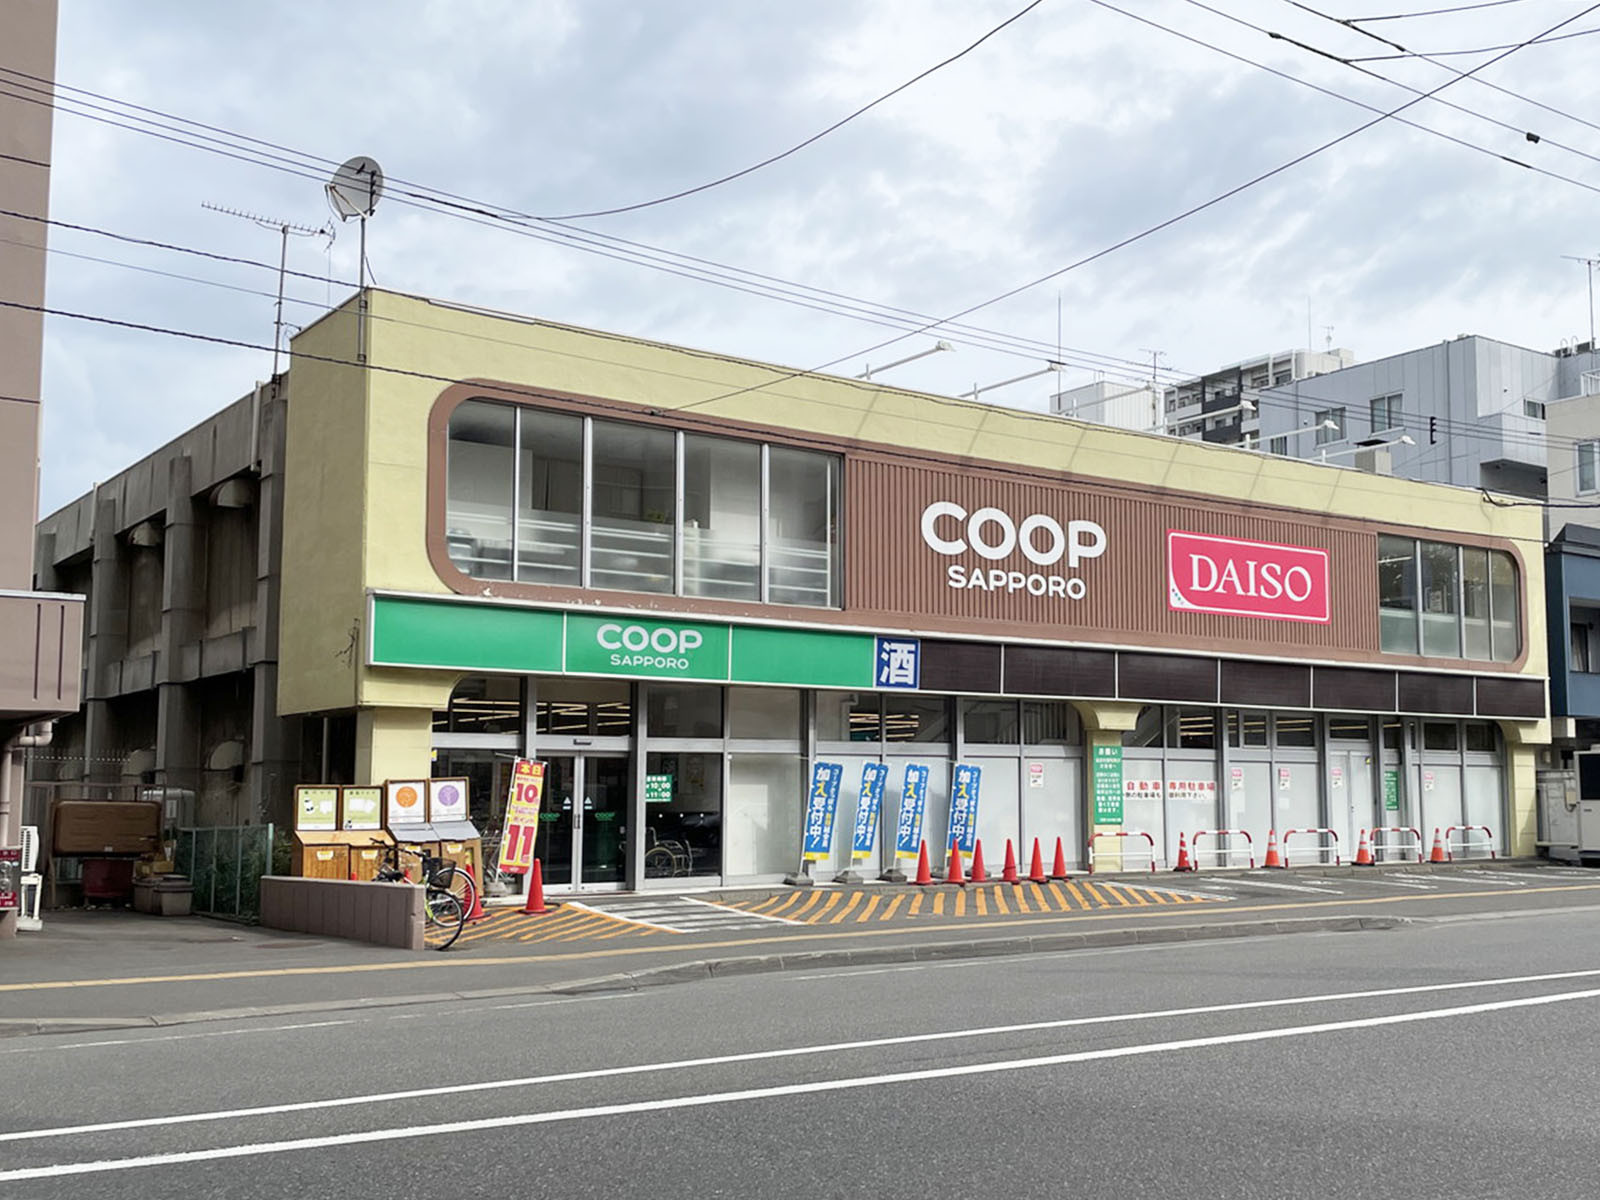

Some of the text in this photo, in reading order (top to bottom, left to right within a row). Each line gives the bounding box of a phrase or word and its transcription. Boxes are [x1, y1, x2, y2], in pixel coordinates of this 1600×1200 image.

[921, 501, 1107, 568] COOP
[948, 565, 1086, 600] SAPPORO
[1189, 554, 1312, 602] DAISO
[597, 623, 703, 654] COOP
[610, 654, 689, 670] SAPPORO
[880, 641, 916, 685] 酒
[520, 764, 542, 776] 本日
